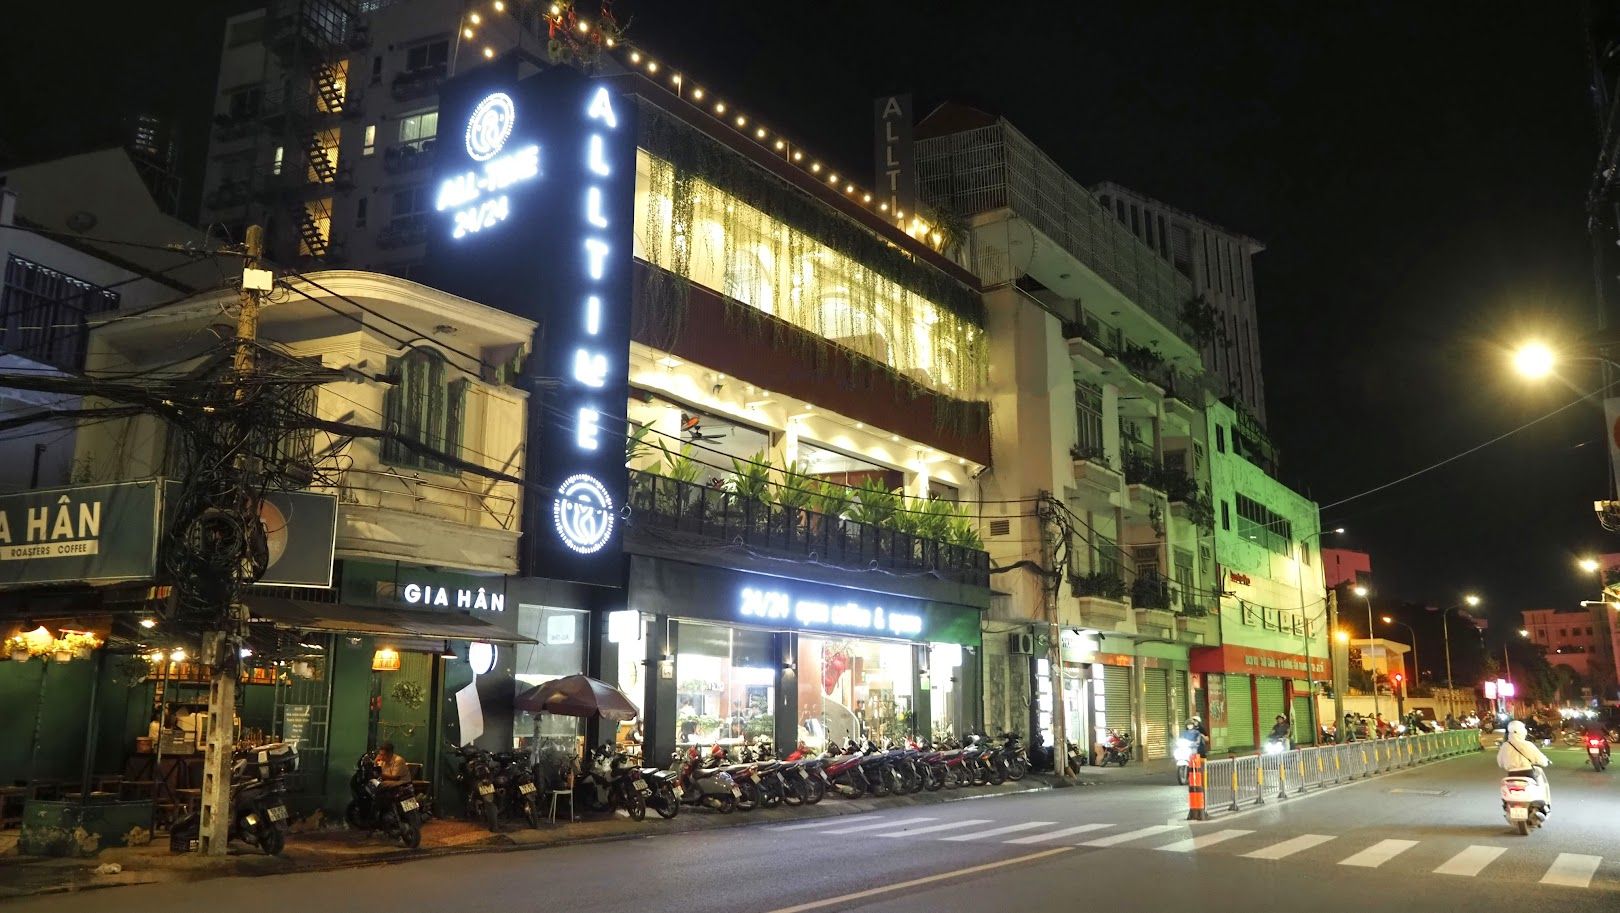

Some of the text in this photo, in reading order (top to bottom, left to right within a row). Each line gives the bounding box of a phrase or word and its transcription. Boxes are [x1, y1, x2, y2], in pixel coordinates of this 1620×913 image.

[453, 196, 509, 238] 24/24
[27, 495, 101, 542] HÂN
[11, 544, 87, 557] ROASTERS COFFEE
[404, 583, 504, 612] GIA HÂN
[741, 587, 789, 619] 24/24
